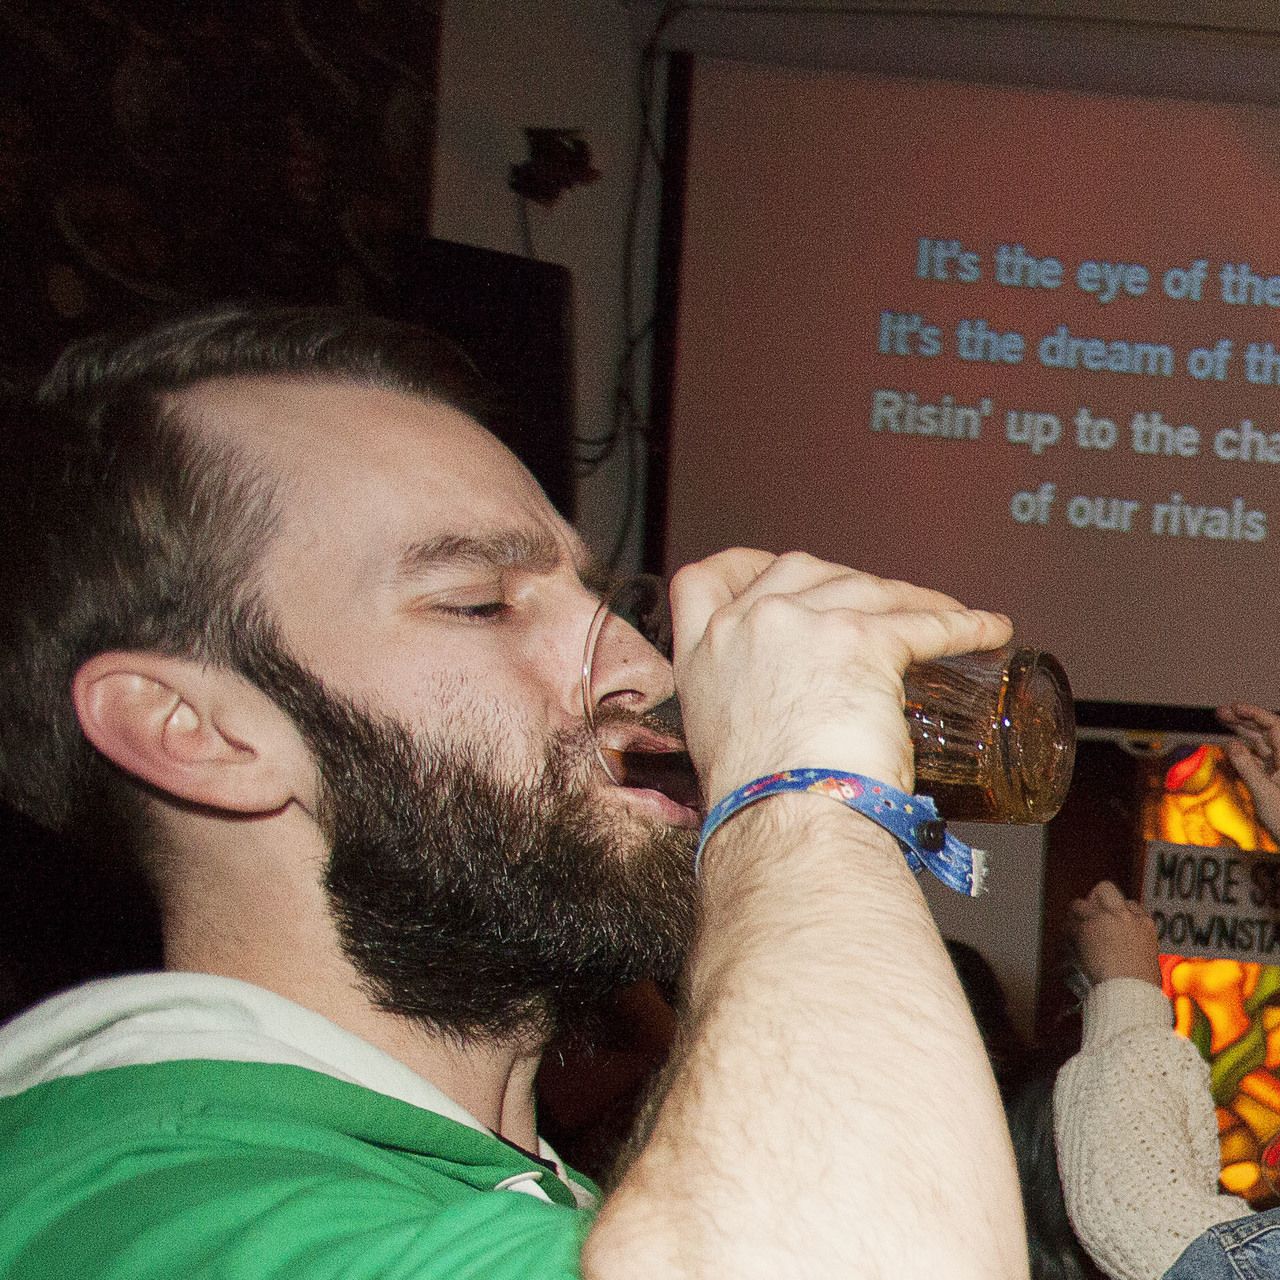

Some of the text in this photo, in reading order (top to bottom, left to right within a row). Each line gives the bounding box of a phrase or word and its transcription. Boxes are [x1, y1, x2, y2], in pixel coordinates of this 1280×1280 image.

[917, 237, 980, 283] It's
[995, 243, 1063, 290] the
[1076, 258, 1150, 304] eye
[1163, 260, 1208, 300] of
[879, 311, 943, 356] It's
[957, 318, 1025, 364] the
[1038, 326, 1174, 376] dream
[1187, 339, 1232, 380] of
[870, 389, 992, 440] Risin'
[1006, 410, 1061, 455] up
[1075, 407, 1117, 450] to
[1131, 411, 1201, 457] the
[1010, 483, 1267, 543] of our rivals
[1153, 853, 1242, 903] MORE
